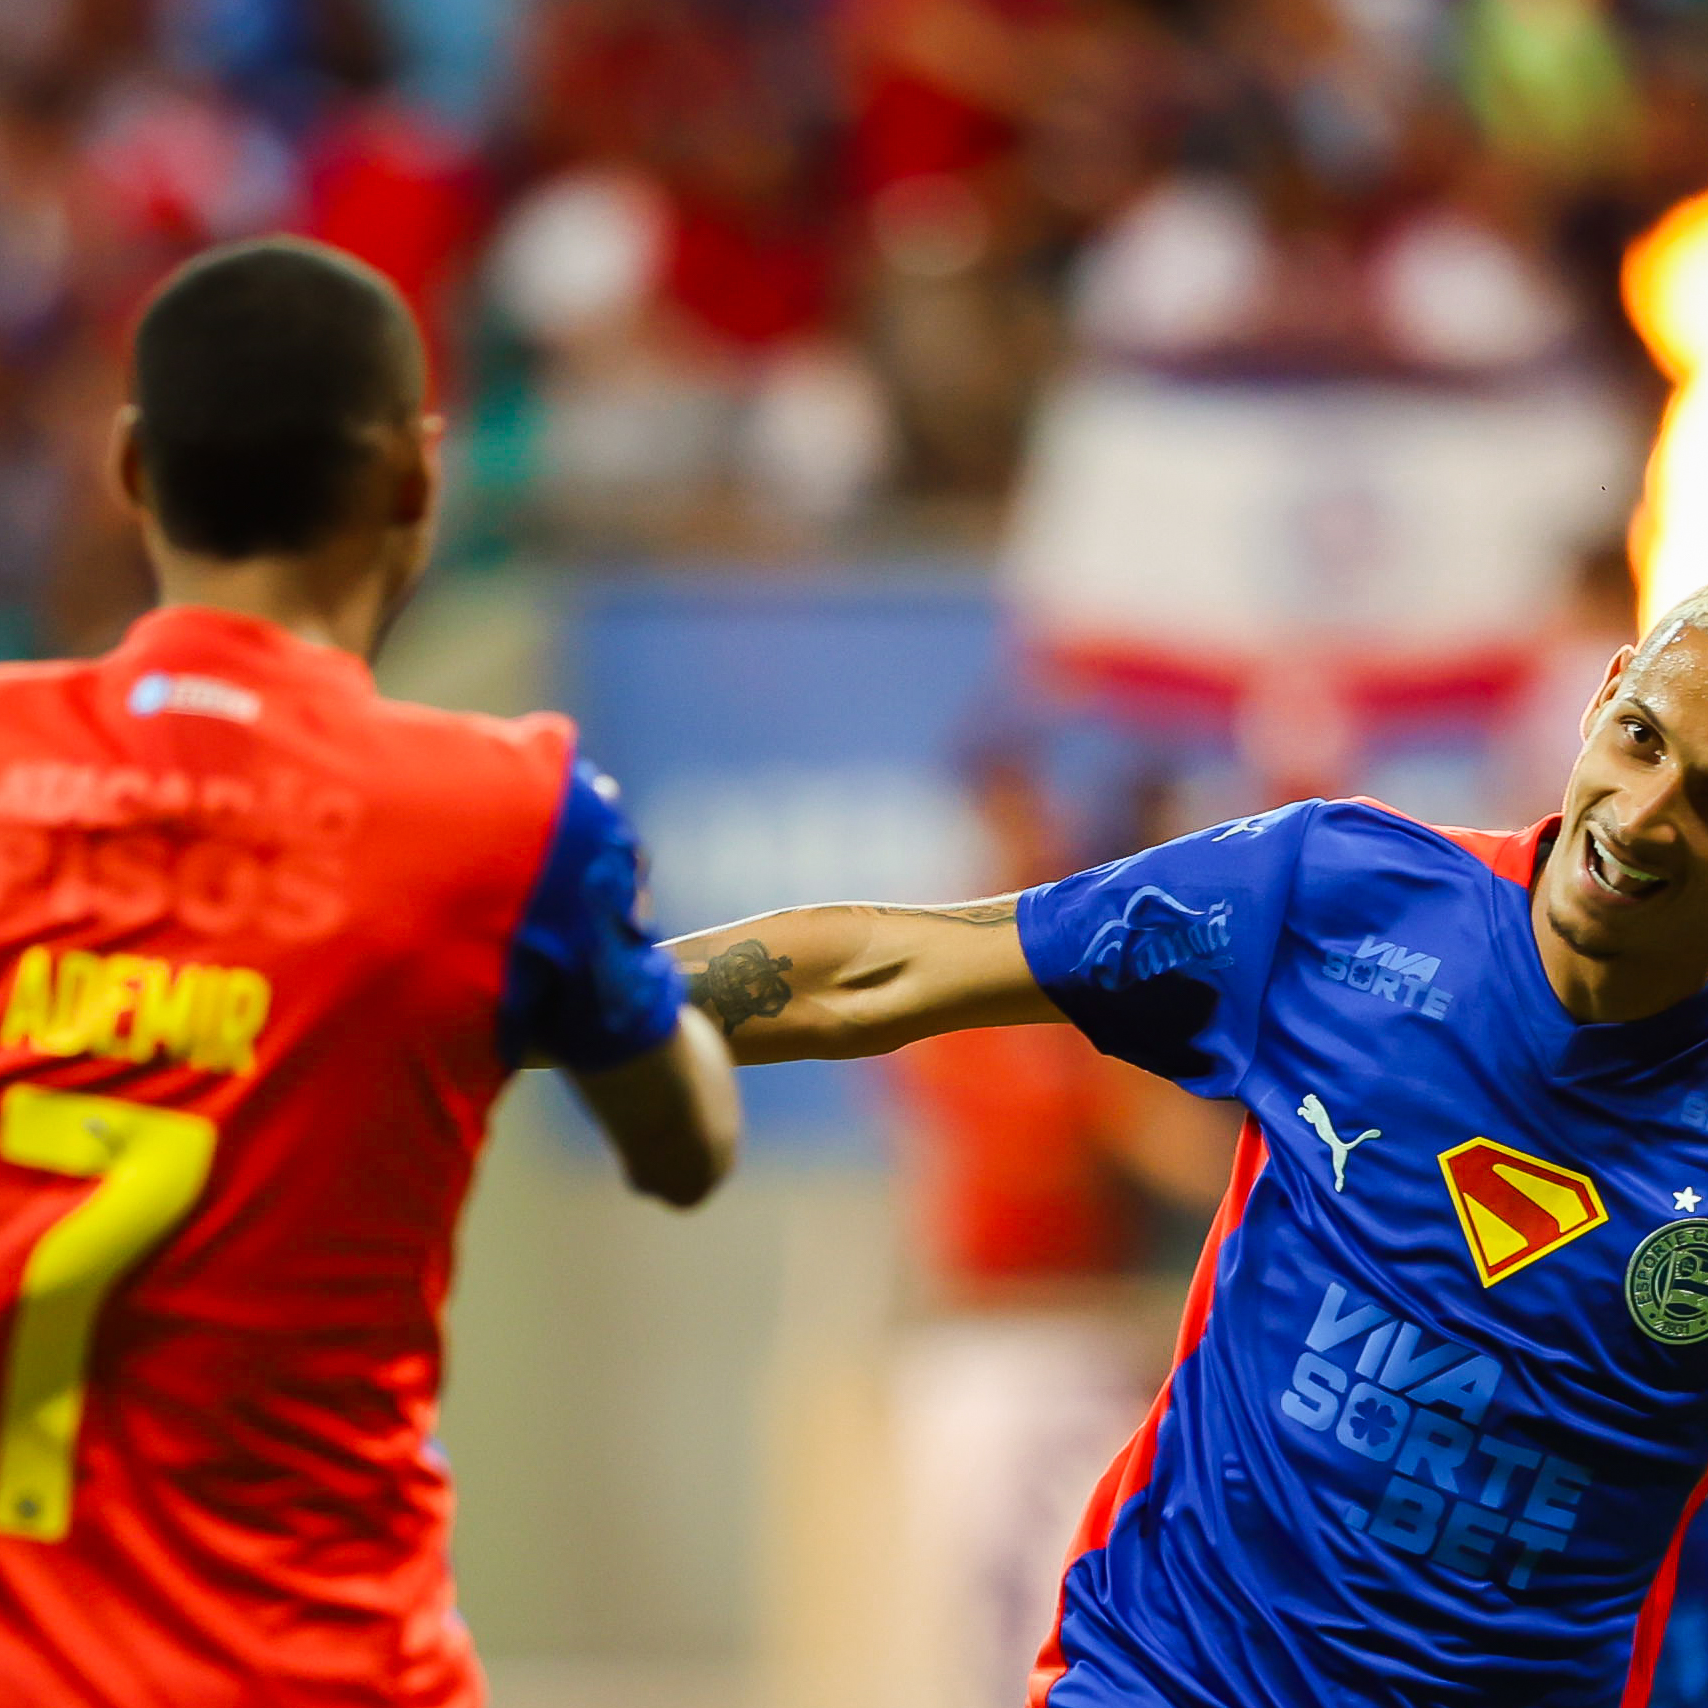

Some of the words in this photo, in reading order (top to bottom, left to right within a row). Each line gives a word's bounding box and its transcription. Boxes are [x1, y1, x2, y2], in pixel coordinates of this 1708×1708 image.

[0, 944, 273, 1076] ADEMIR
[1322, 951, 1454, 1021] SORTE
[1354, 934, 1441, 983] VIVA
[1635, 1230, 1686, 1307] ESPORTE
[1305, 1281, 1503, 1425] VIVA
[1281, 1352, 1592, 1530] SORTE
[1344, 1475, 1569, 1590] .BET
